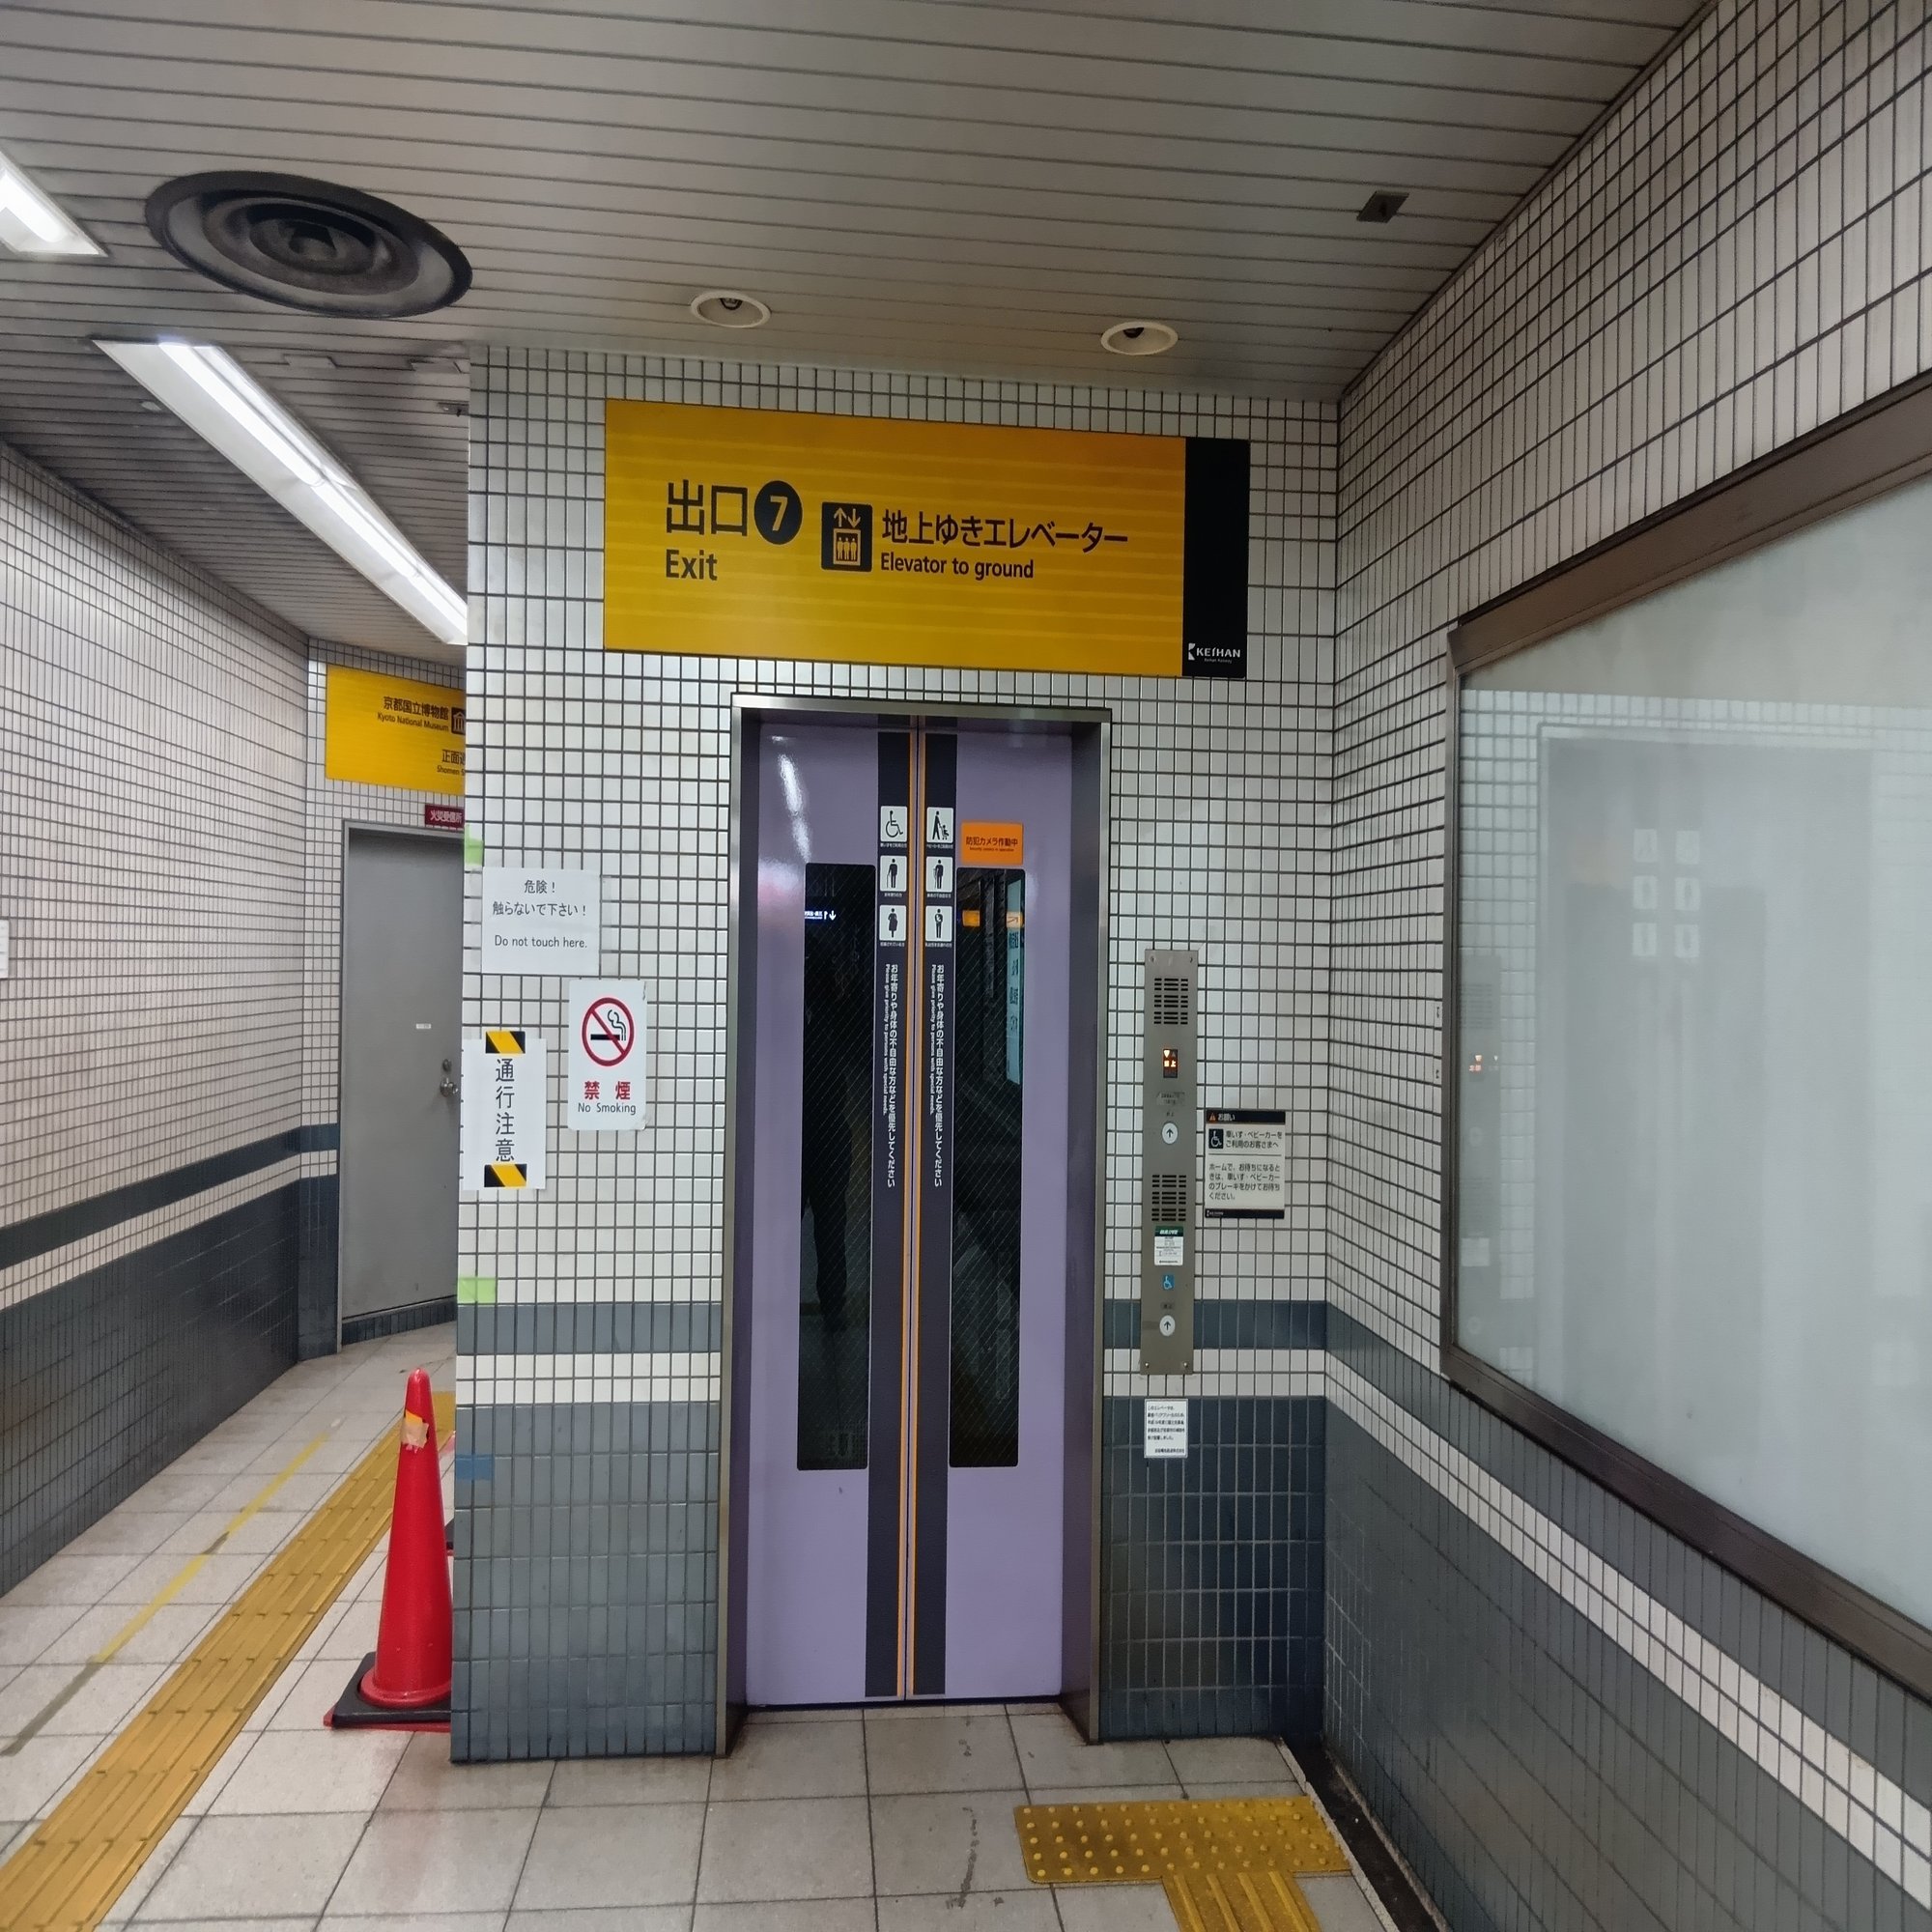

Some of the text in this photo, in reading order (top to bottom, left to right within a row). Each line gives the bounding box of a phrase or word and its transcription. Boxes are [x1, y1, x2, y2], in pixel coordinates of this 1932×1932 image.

[666, 479, 789, 536] 出口 7
[882, 509, 1128, 554] 地上ゆきエレベーター
[666, 549, 718, 581] Exit
[881, 552, 1035, 581] Elevator to ground
[1197, 647, 1241, 658] KEIHAN
[384, 696, 449, 721] 京都国立博物館
[377, 712, 449, 731] Kyoto National Museum
[495, 935, 587, 949] Do not touch here.
[584, 1080, 631, 1100] 禁煙
[496, 1059, 515, 1162] 通行注意
[578, 1102, 636, 1116] No Smoking
